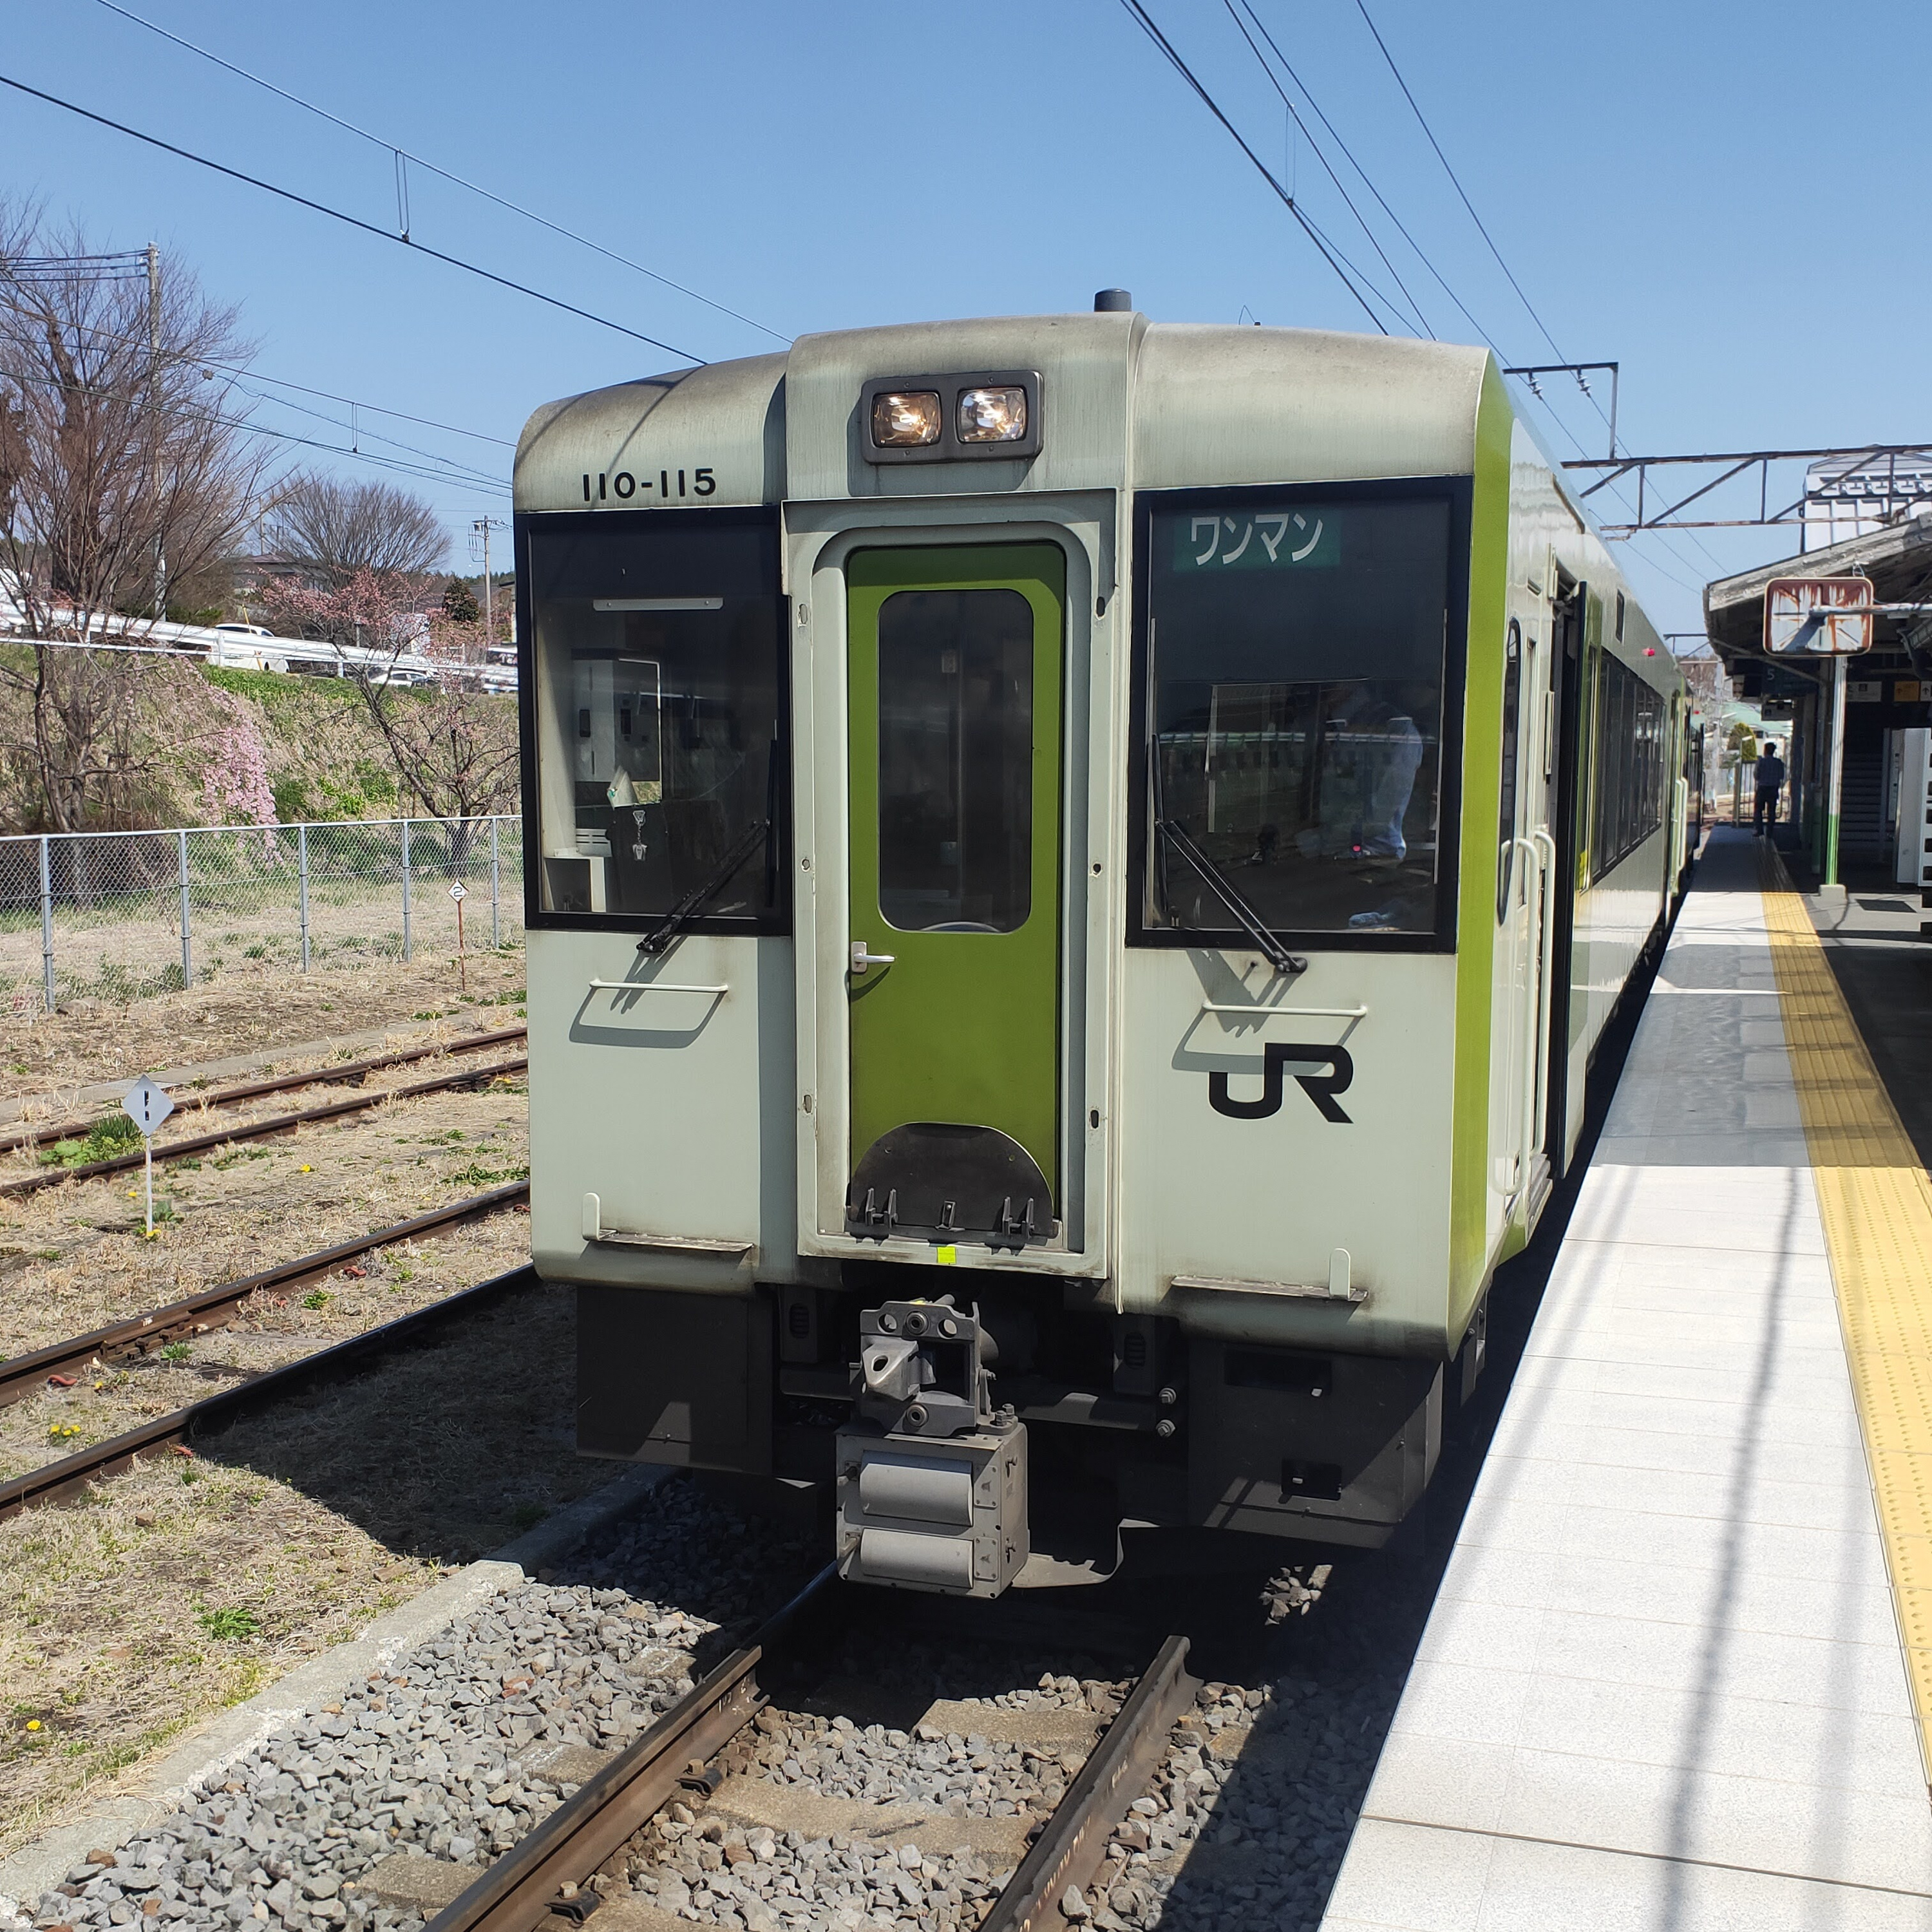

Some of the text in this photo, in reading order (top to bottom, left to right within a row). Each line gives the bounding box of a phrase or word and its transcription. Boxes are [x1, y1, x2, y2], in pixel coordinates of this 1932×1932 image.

[583, 468, 716, 502] 110-115
[1191, 513, 1323, 565] ワンマン
[453, 886, 463, 897] 2
[1209, 1042, 1354, 1124] JR
